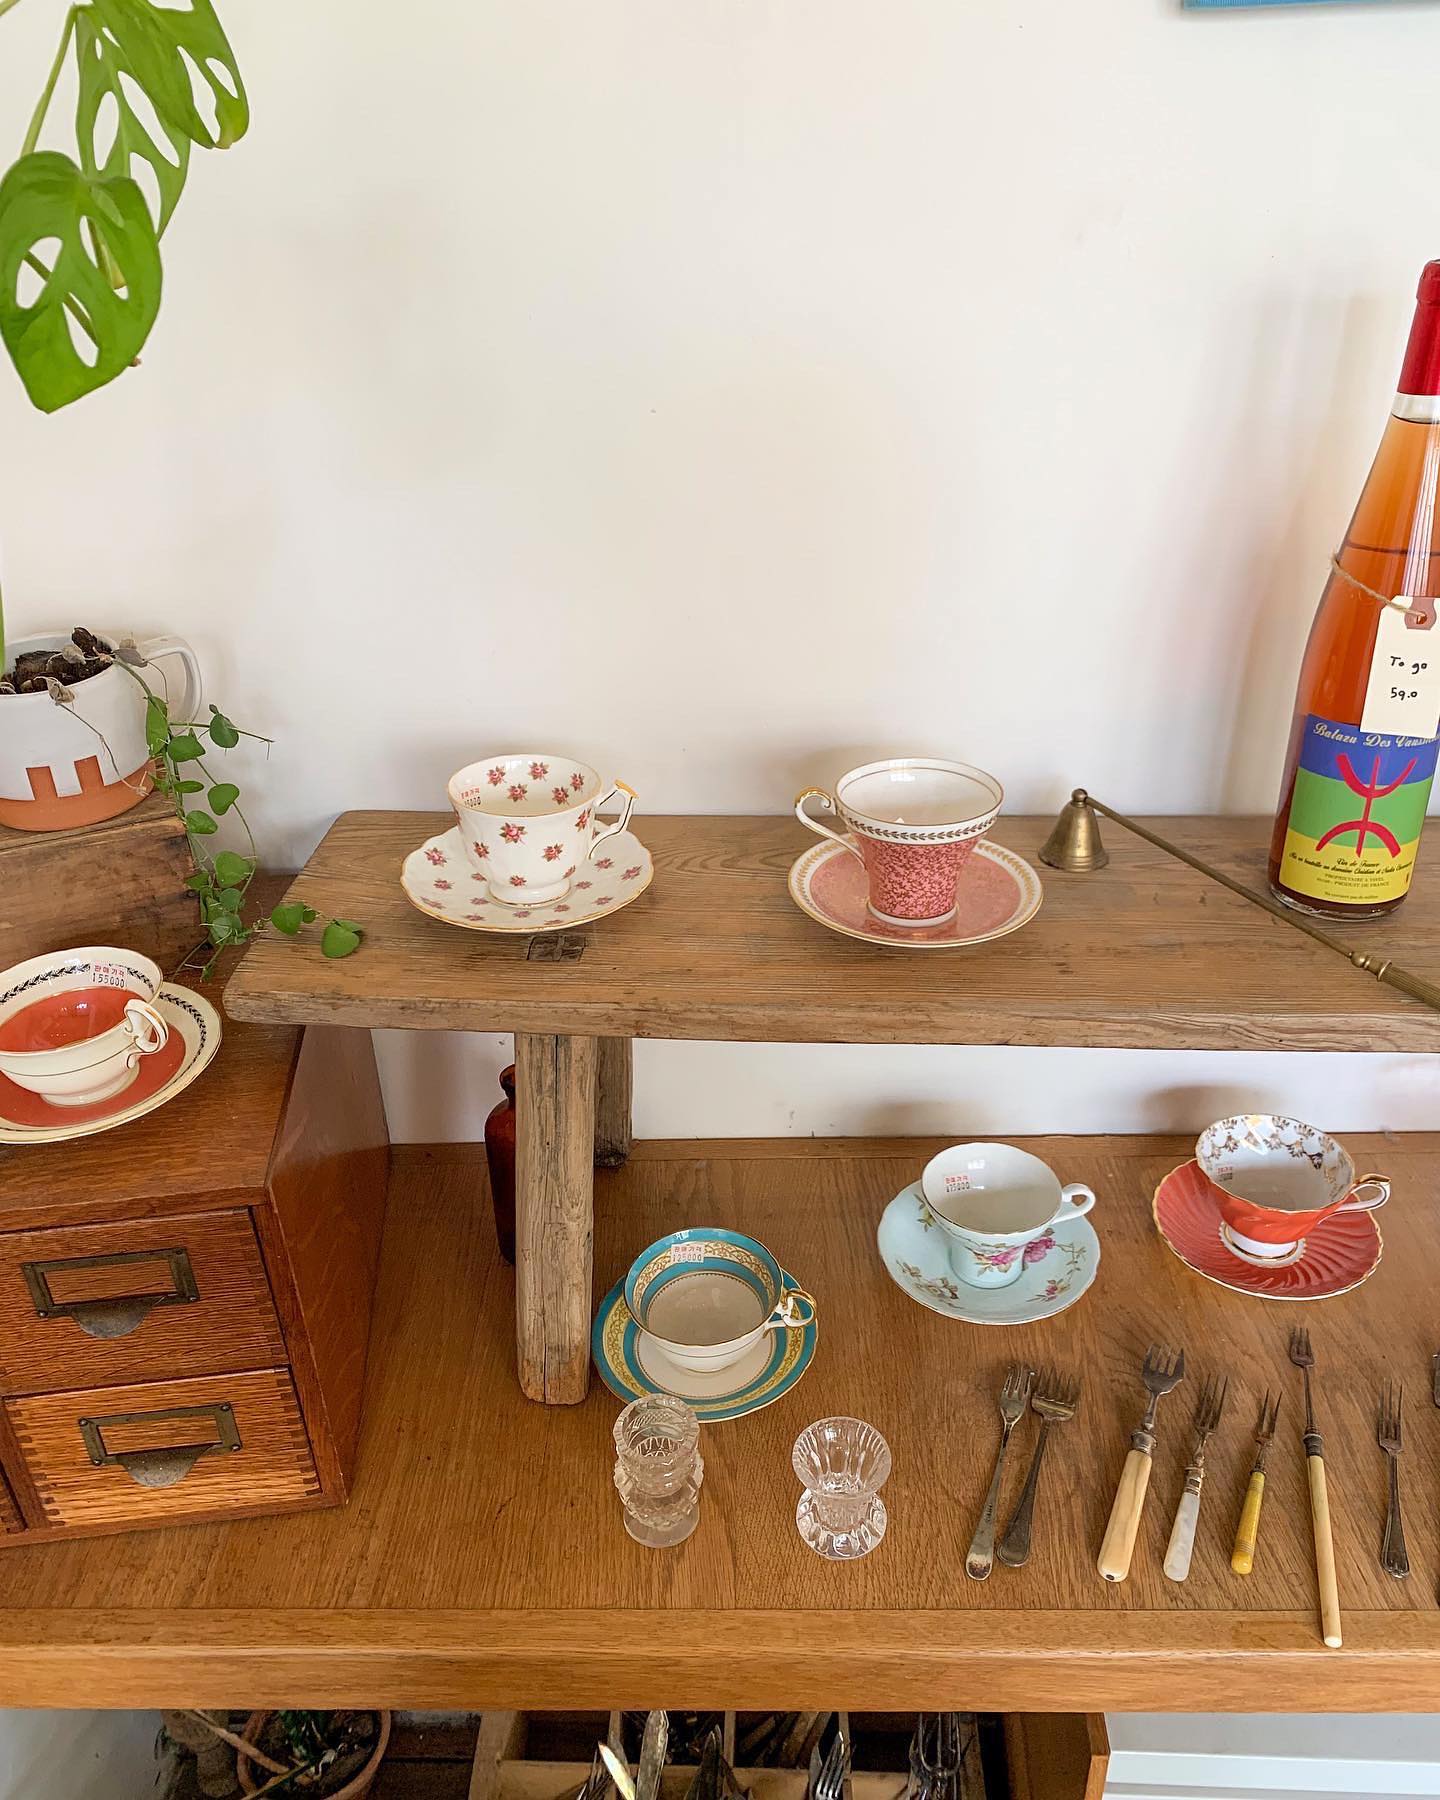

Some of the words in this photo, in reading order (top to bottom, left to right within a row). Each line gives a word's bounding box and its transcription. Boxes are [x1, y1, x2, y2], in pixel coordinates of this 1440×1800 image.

[1390, 655, 1405, 667] To
[1411, 662, 1428, 675] go
[1313, 722, 1358, 744] Balazu
[1363, 734, 1391, 747] Des
[94, 964, 125, 977] 판매가격
[92, 972, 125, 988] 155000
[672, 1253, 702, 1262] 125000
